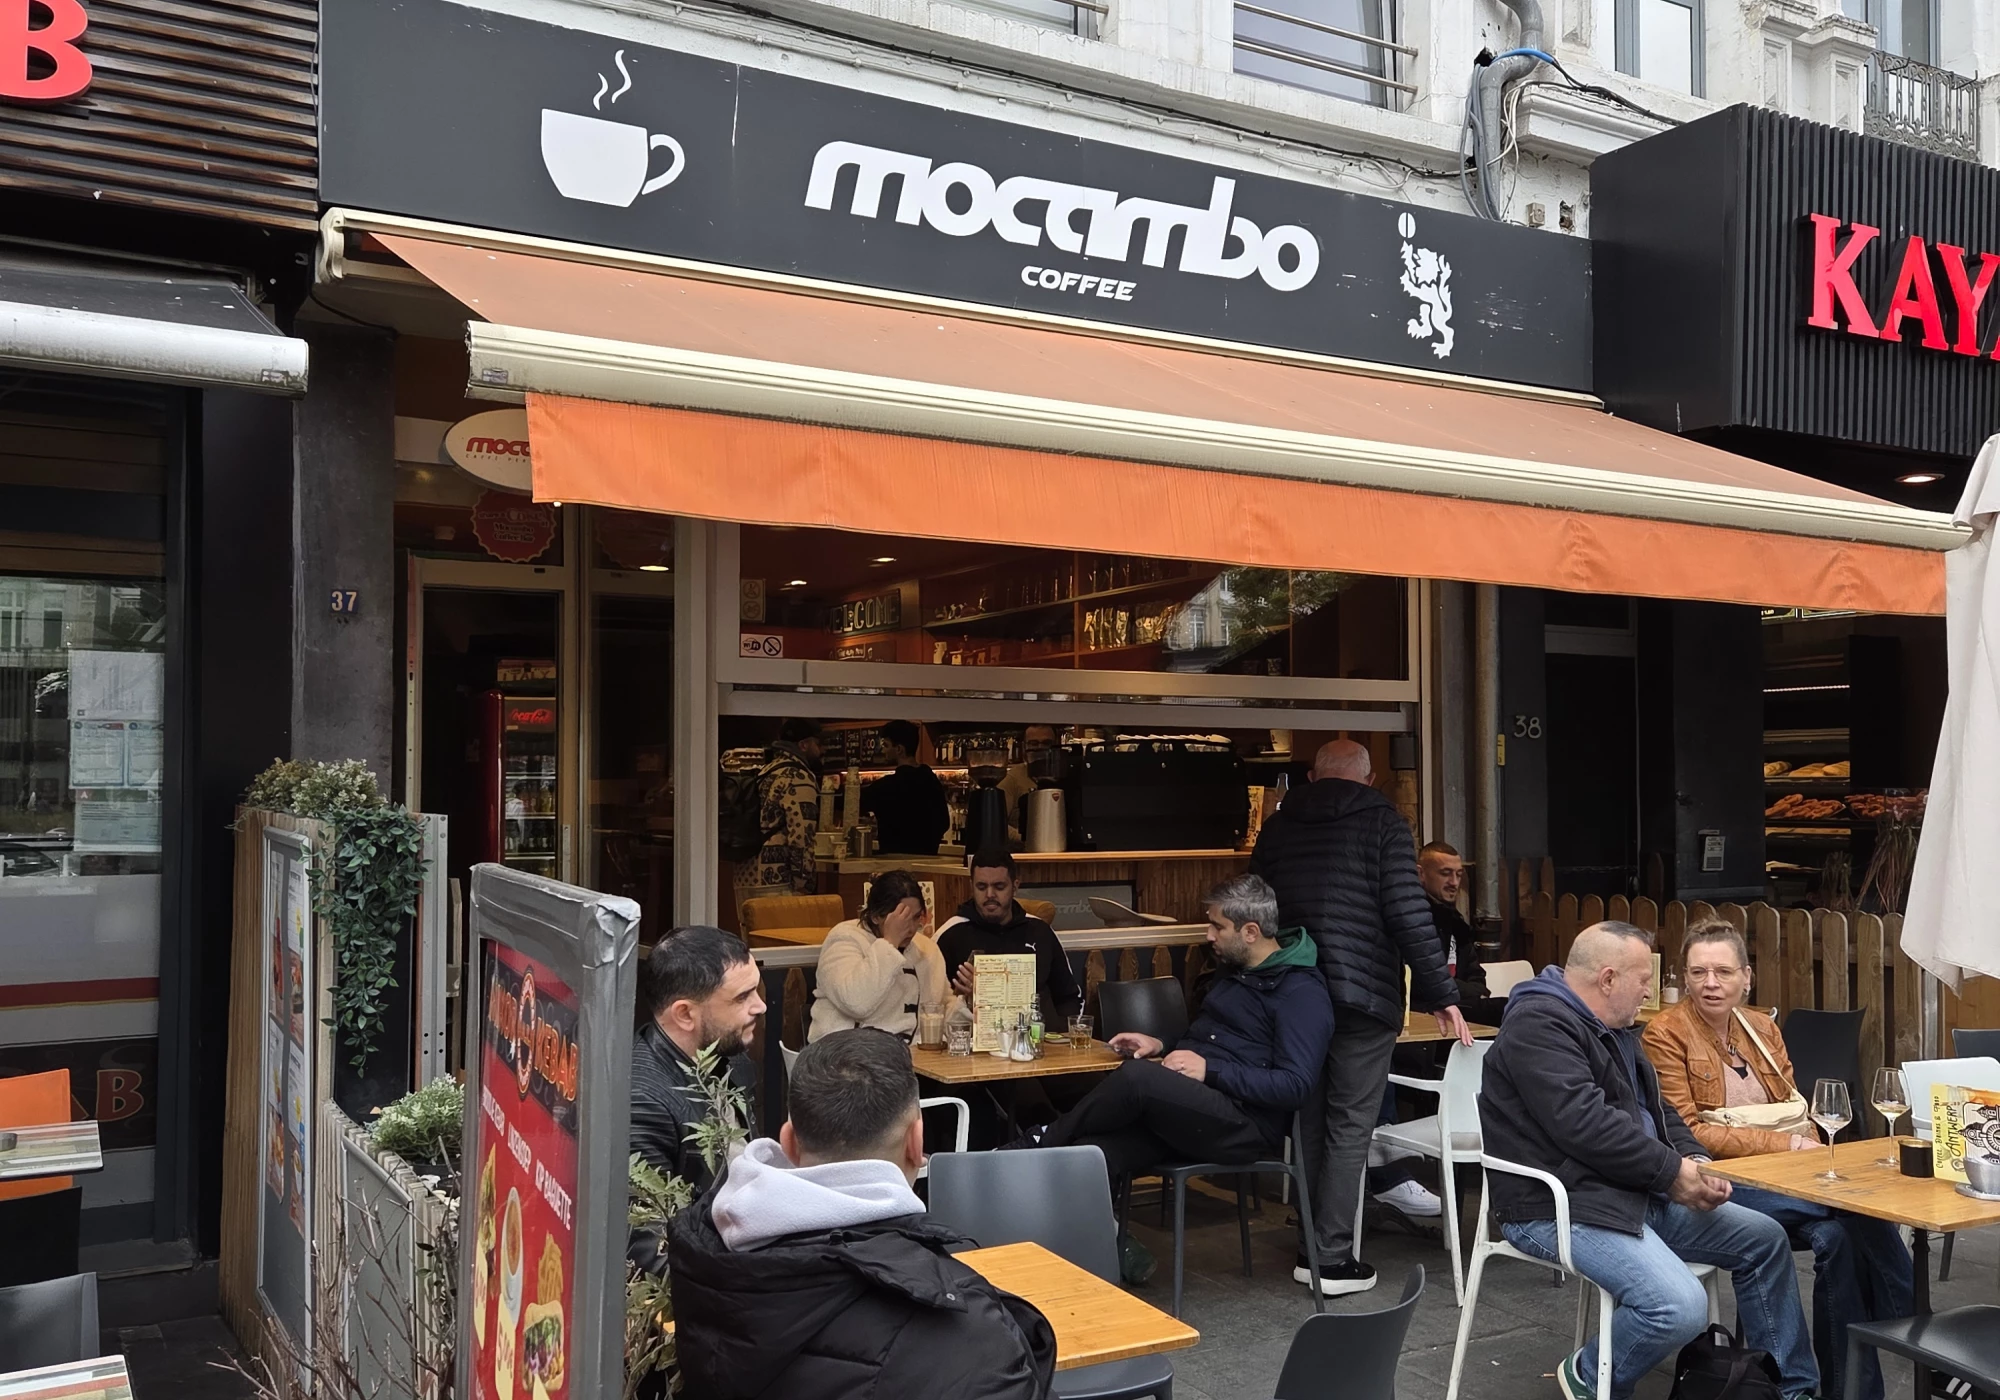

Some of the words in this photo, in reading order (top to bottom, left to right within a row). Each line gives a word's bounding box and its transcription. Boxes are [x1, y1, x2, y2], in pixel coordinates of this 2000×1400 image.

[804, 140, 1319, 291] mocambo
[1021, 265, 1137, 301] COFFEE
[1808, 213, 2000, 361] KAY
[331, 591, 357, 611] 37
[1513, 715, 1541, 738] 38
[1945, 1105, 1962, 1157] ANTWERP
